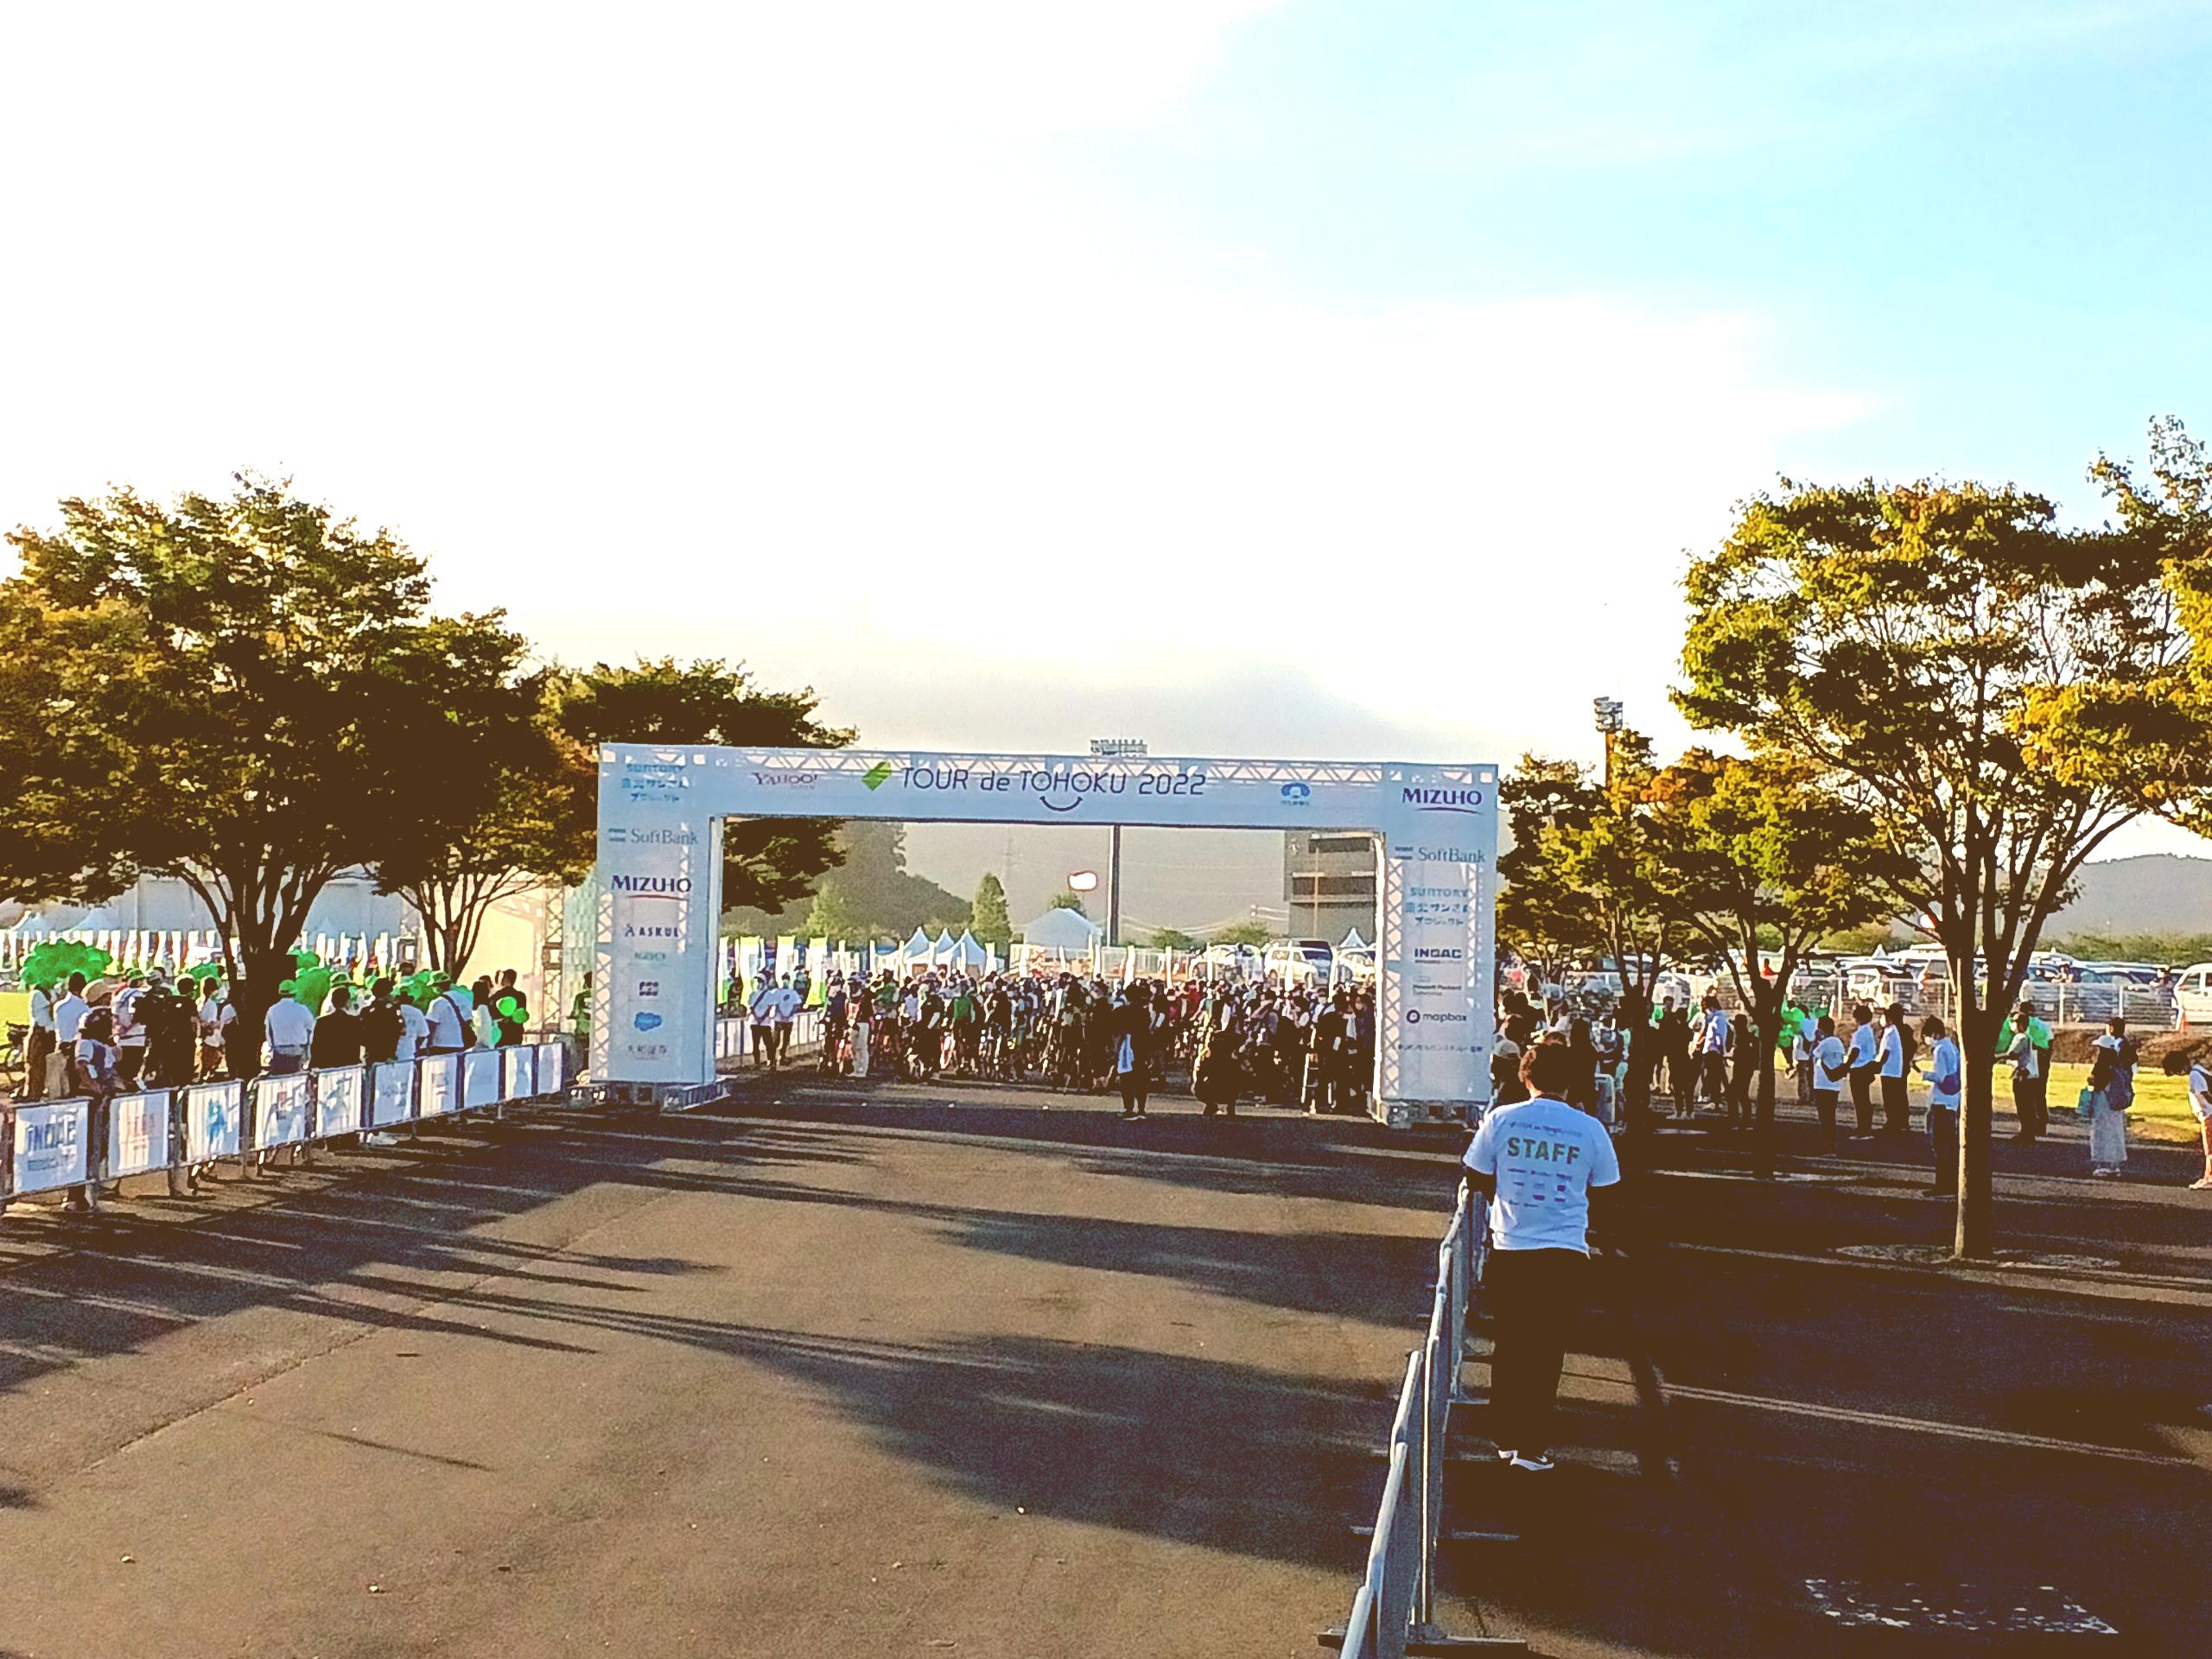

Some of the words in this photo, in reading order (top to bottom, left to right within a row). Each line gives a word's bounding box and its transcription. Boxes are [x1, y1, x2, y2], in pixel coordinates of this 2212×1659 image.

[901, 767, 969, 790] TOUR
[980, 771, 1010, 791] de
[1020, 771, 1127, 793] TOHOKU
[1139, 773, 1206, 795] 2022
[1402, 788, 1483, 804] MIZUHO
[631, 829, 698, 845] SoftBank
[1418, 847, 1485, 863] SoftBank
[611, 875, 692, 893] MIZUHO
[639, 926, 679, 937] ASKUL
[1423, 1013, 1466, 1023] mapbox
[1508, 1136, 1580, 1165] STAFF
